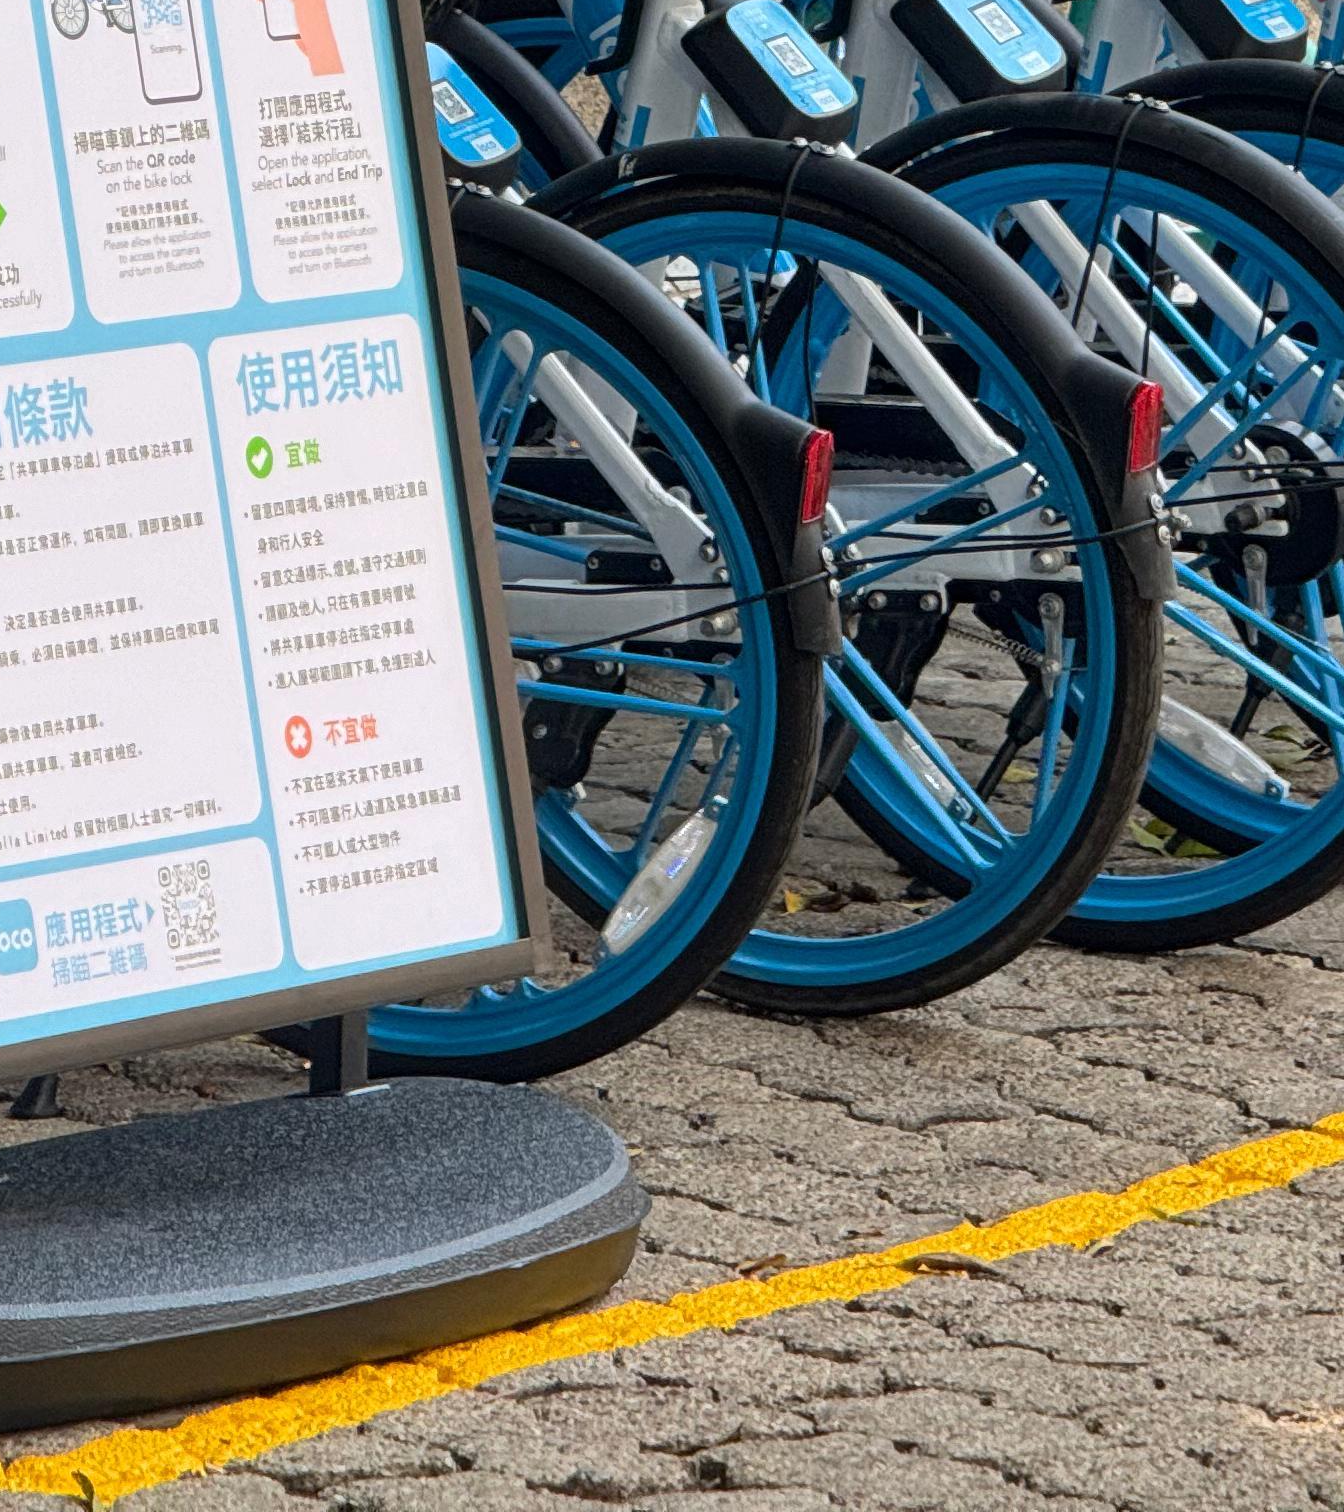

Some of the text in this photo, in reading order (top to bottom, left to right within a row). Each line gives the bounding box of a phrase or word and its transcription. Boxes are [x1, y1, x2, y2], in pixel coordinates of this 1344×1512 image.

[72, 117, 211, 155] 掃瞄車鎖上的二維碼
[257, 116, 362, 148] 選擇「結束行程」
[95, 148, 196, 175] Scan the QR code
[256, 146, 372, 174] Open the application,
[104, 168, 193, 194] on the bike lock
[250, 162, 383, 193] select Lock and End Trip
[234, 337, 404, 417] 使用須知
[283, 438, 322, 468] 宜做
[256, 527, 325, 555] 身和行人安全
[322, 713, 379, 746] 不宜做
[23, 824, 69, 846] Limited
[43, 896, 143, 949] 應用程式
[49, 941, 148, 988] 掃瞄二維碼
